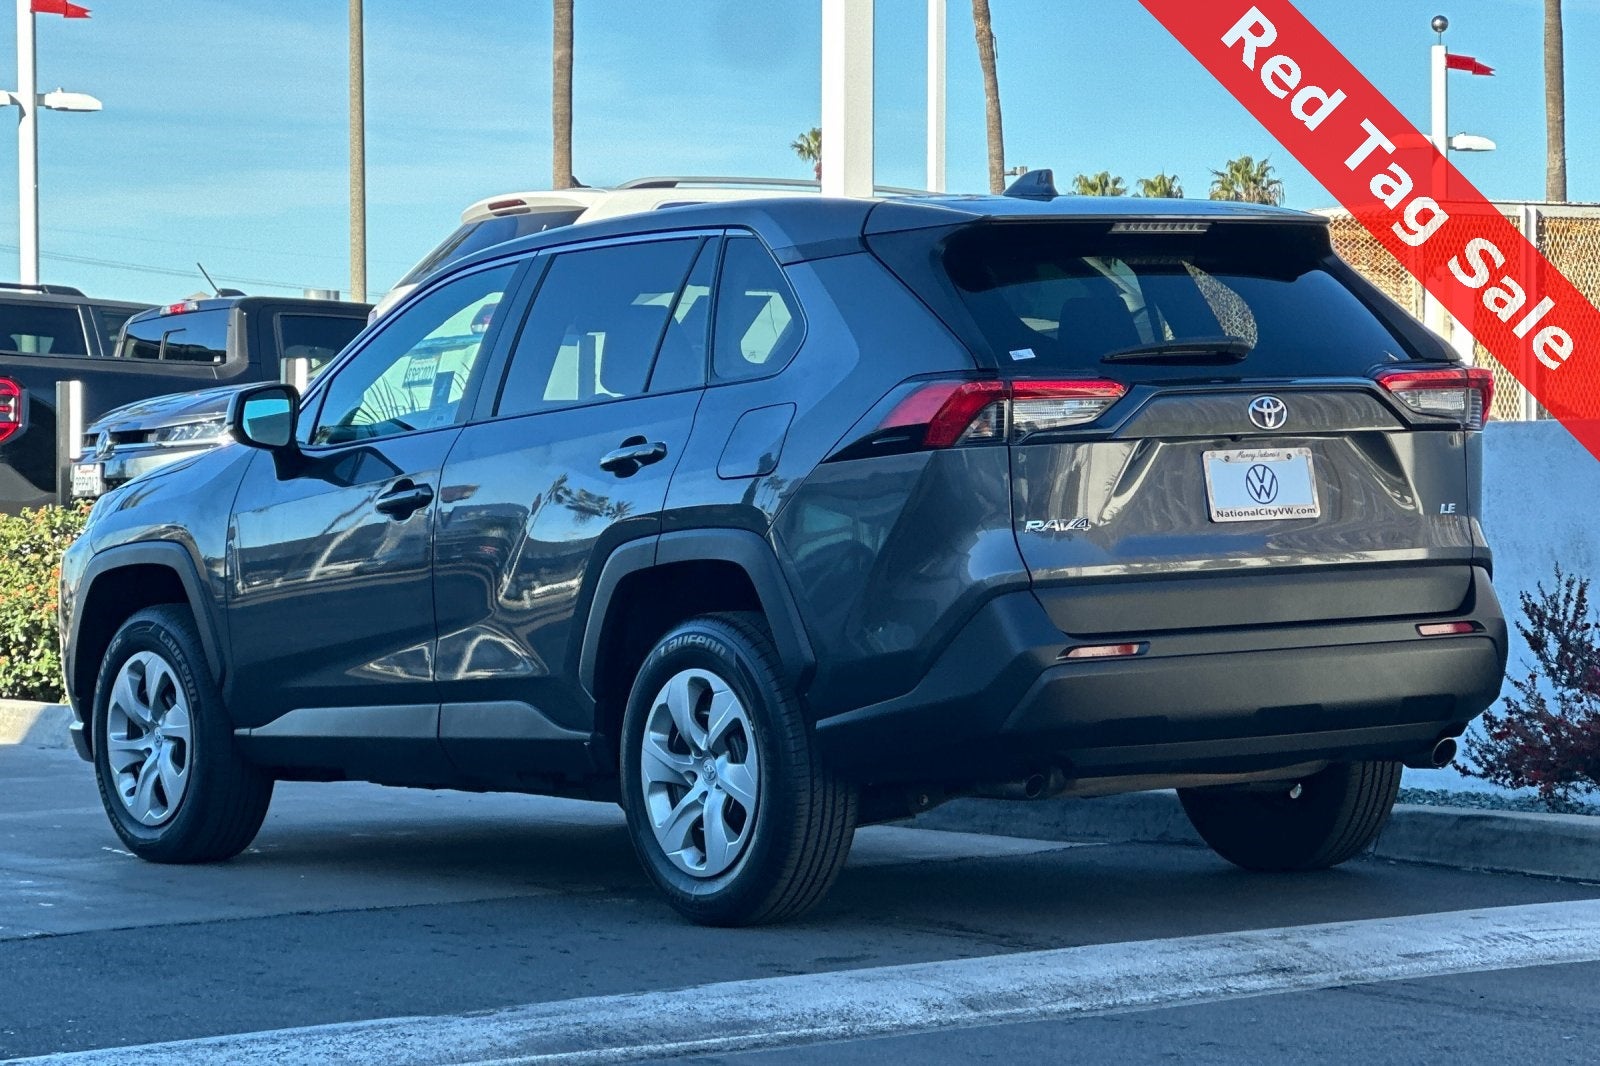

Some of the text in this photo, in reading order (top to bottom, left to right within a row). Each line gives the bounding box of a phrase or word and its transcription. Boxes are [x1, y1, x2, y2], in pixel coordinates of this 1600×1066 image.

[1216, 507, 1316, 518] NationalCityVW.com
[1440, 503, 1456, 514] LE
[1025, 518, 1091, 533] RAV4
